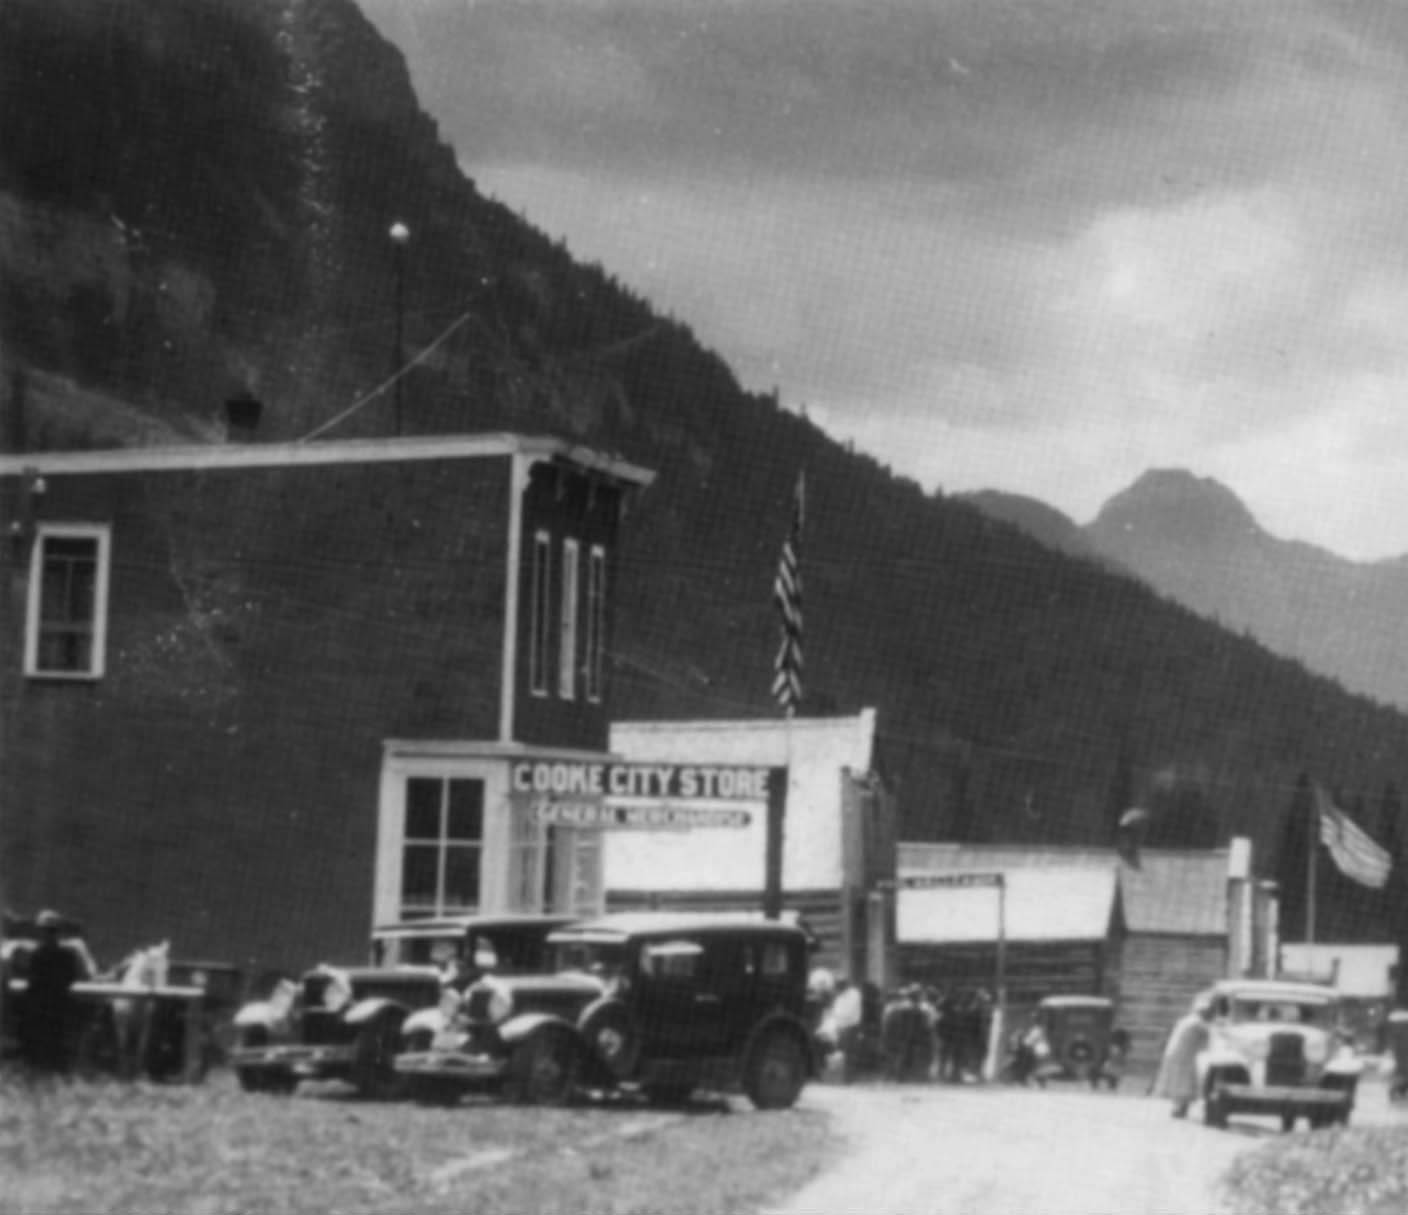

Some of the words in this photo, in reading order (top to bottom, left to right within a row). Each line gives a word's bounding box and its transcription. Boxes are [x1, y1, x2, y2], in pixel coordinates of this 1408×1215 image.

[514, 762, 604, 793] COOKE
[609, 766, 674, 796] CITY
[679, 768, 770, 799] STORE
[536, 803, 617, 826] GENERAL
